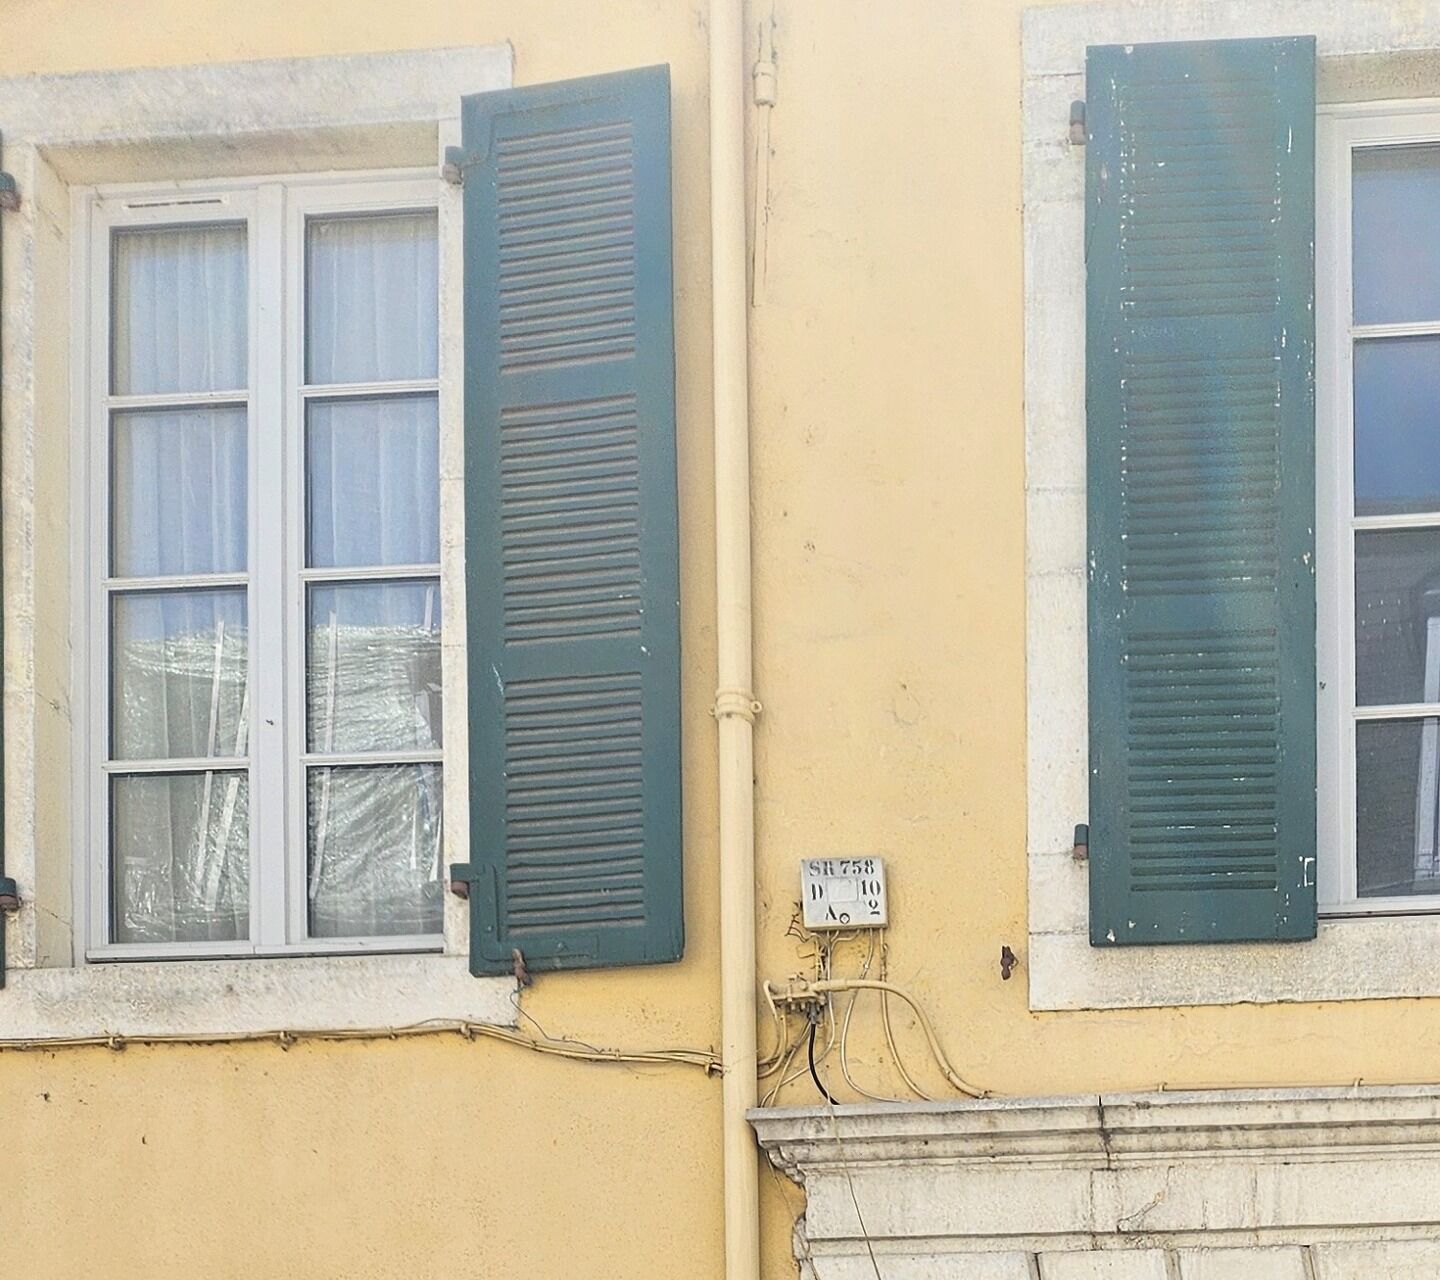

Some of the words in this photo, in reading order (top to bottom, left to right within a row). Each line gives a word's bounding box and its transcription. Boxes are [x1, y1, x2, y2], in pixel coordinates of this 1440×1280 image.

[809, 860, 834, 877] SR
[840, 859, 875, 876] 758
[811, 883, 824, 901] D
[861, 879, 881, 896] 10
